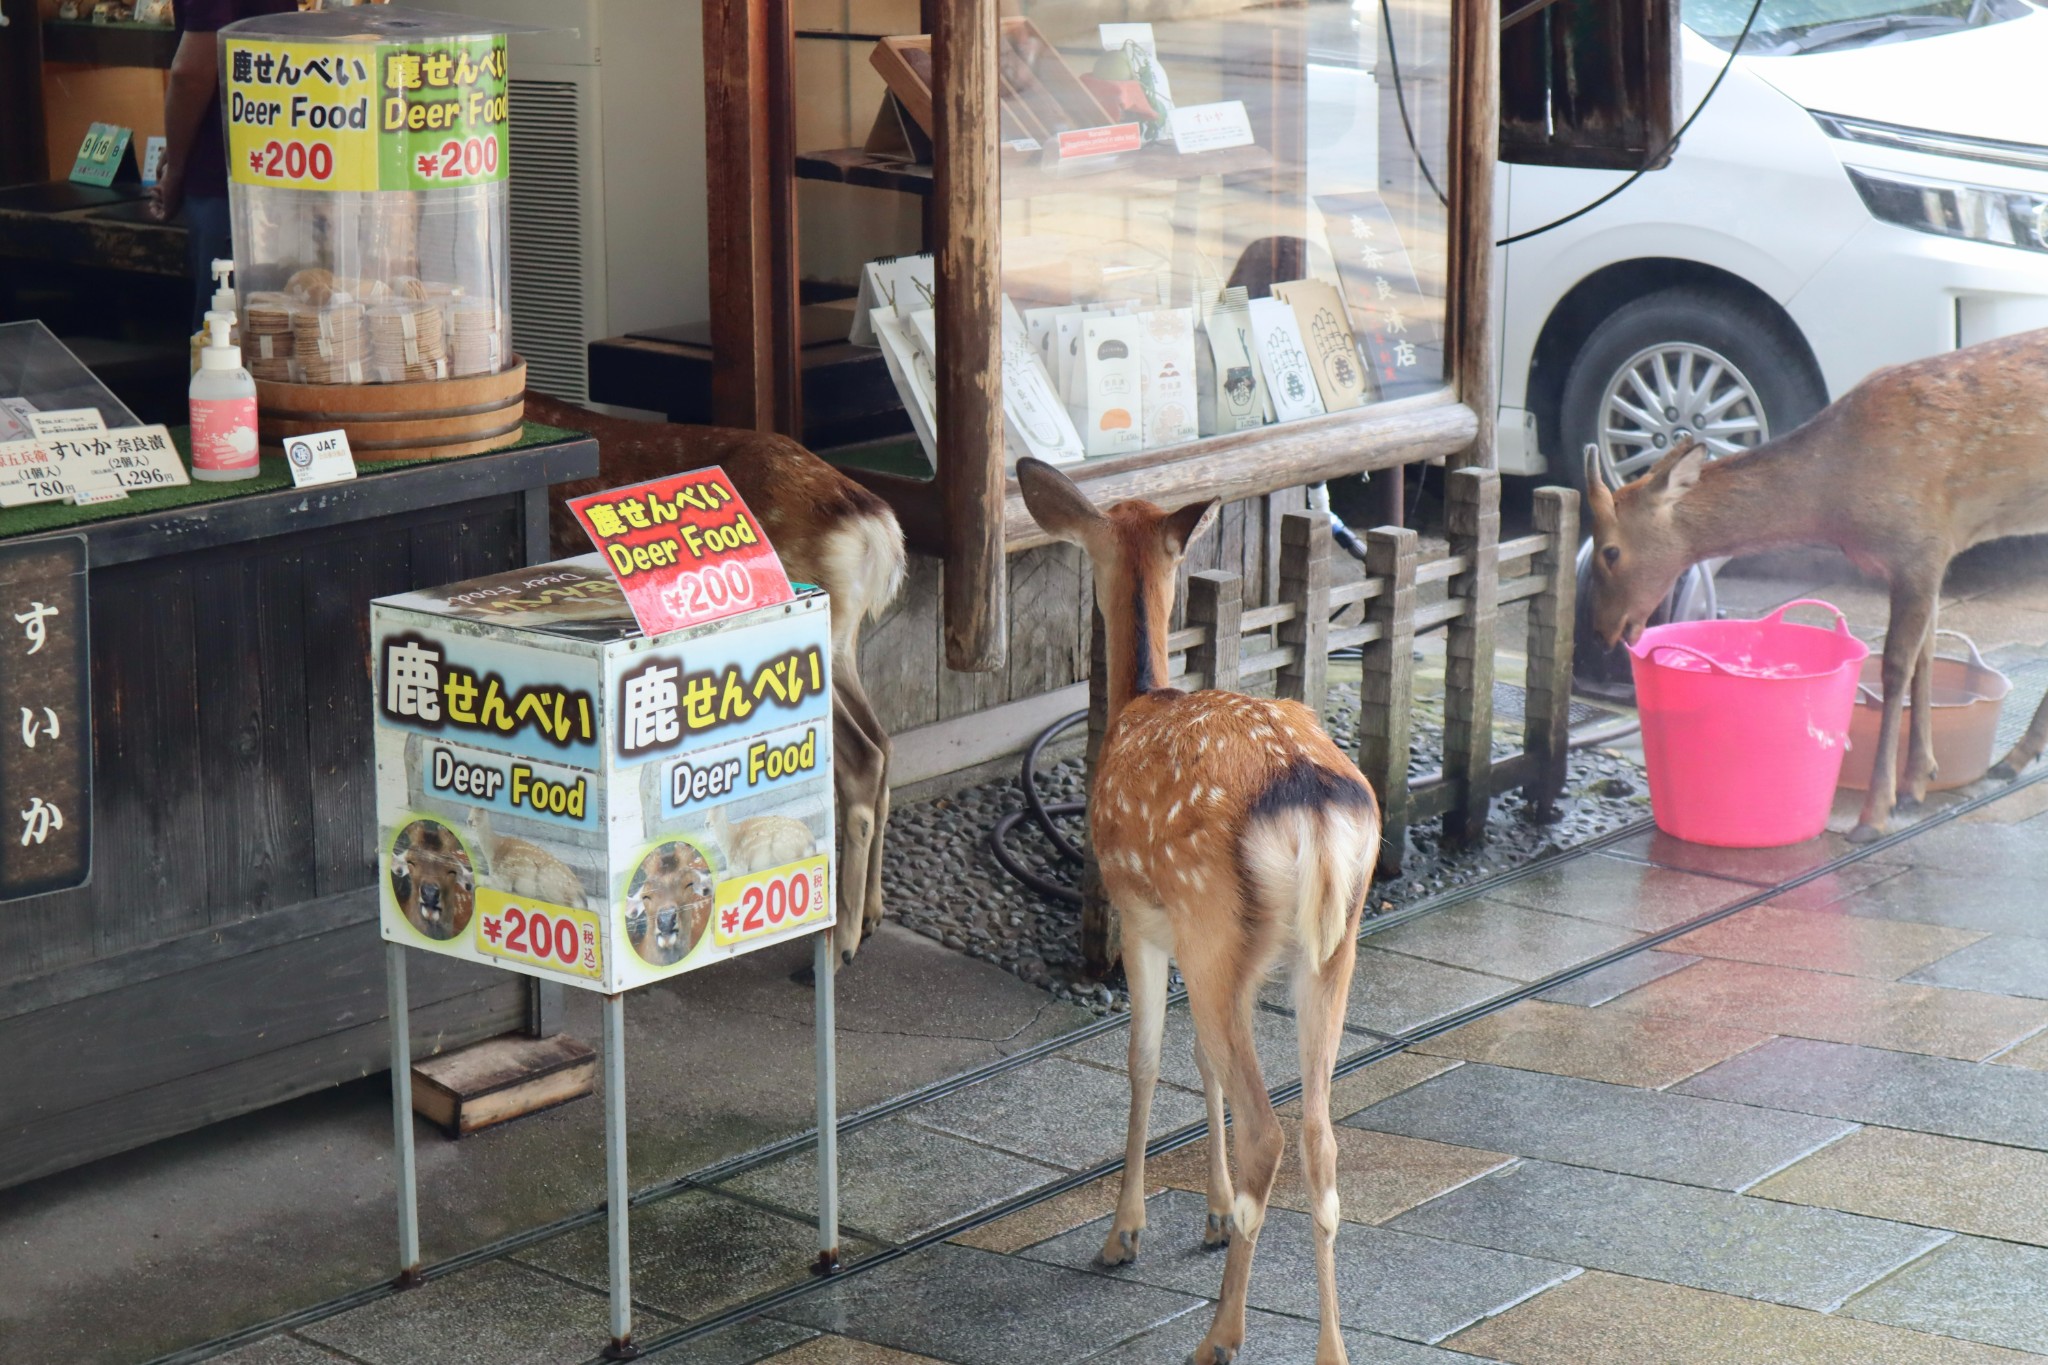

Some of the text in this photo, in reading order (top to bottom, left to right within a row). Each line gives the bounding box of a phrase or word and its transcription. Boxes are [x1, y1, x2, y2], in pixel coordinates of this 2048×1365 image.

[232, 50, 366, 86] 鹿せんべい
[232, 91, 368, 130] Deer Food
[384, 96, 460, 131] Deer
[250, 140, 333, 180] ¥200
[417, 135, 498, 179] ¥200
[49, 437, 112, 461] すいか
[115, 434, 167, 454] 奈良漬
[316, 438, 337, 452] JAF
[27, 480, 76, 498] 780円
[113, 468, 175, 487] 1,296円
[585, 482, 731, 538] 鹿せんべい
[607, 513, 758, 577] Deer Food
[470, 579, 621, 616] せんべい
[521, 572, 588, 590] Deer
[663, 562, 751, 617] ¥200
[387, 641, 591, 742] 鹿せんべい
[624, 651, 821, 750] 鹿せんべい
[14, 602, 63, 847] すいか
[434, 750, 585, 818] Deer Food
[673, 730, 815, 806] Deer Food
[720, 872, 810, 935] ¥200
[483, 907, 579, 964] ¥200
